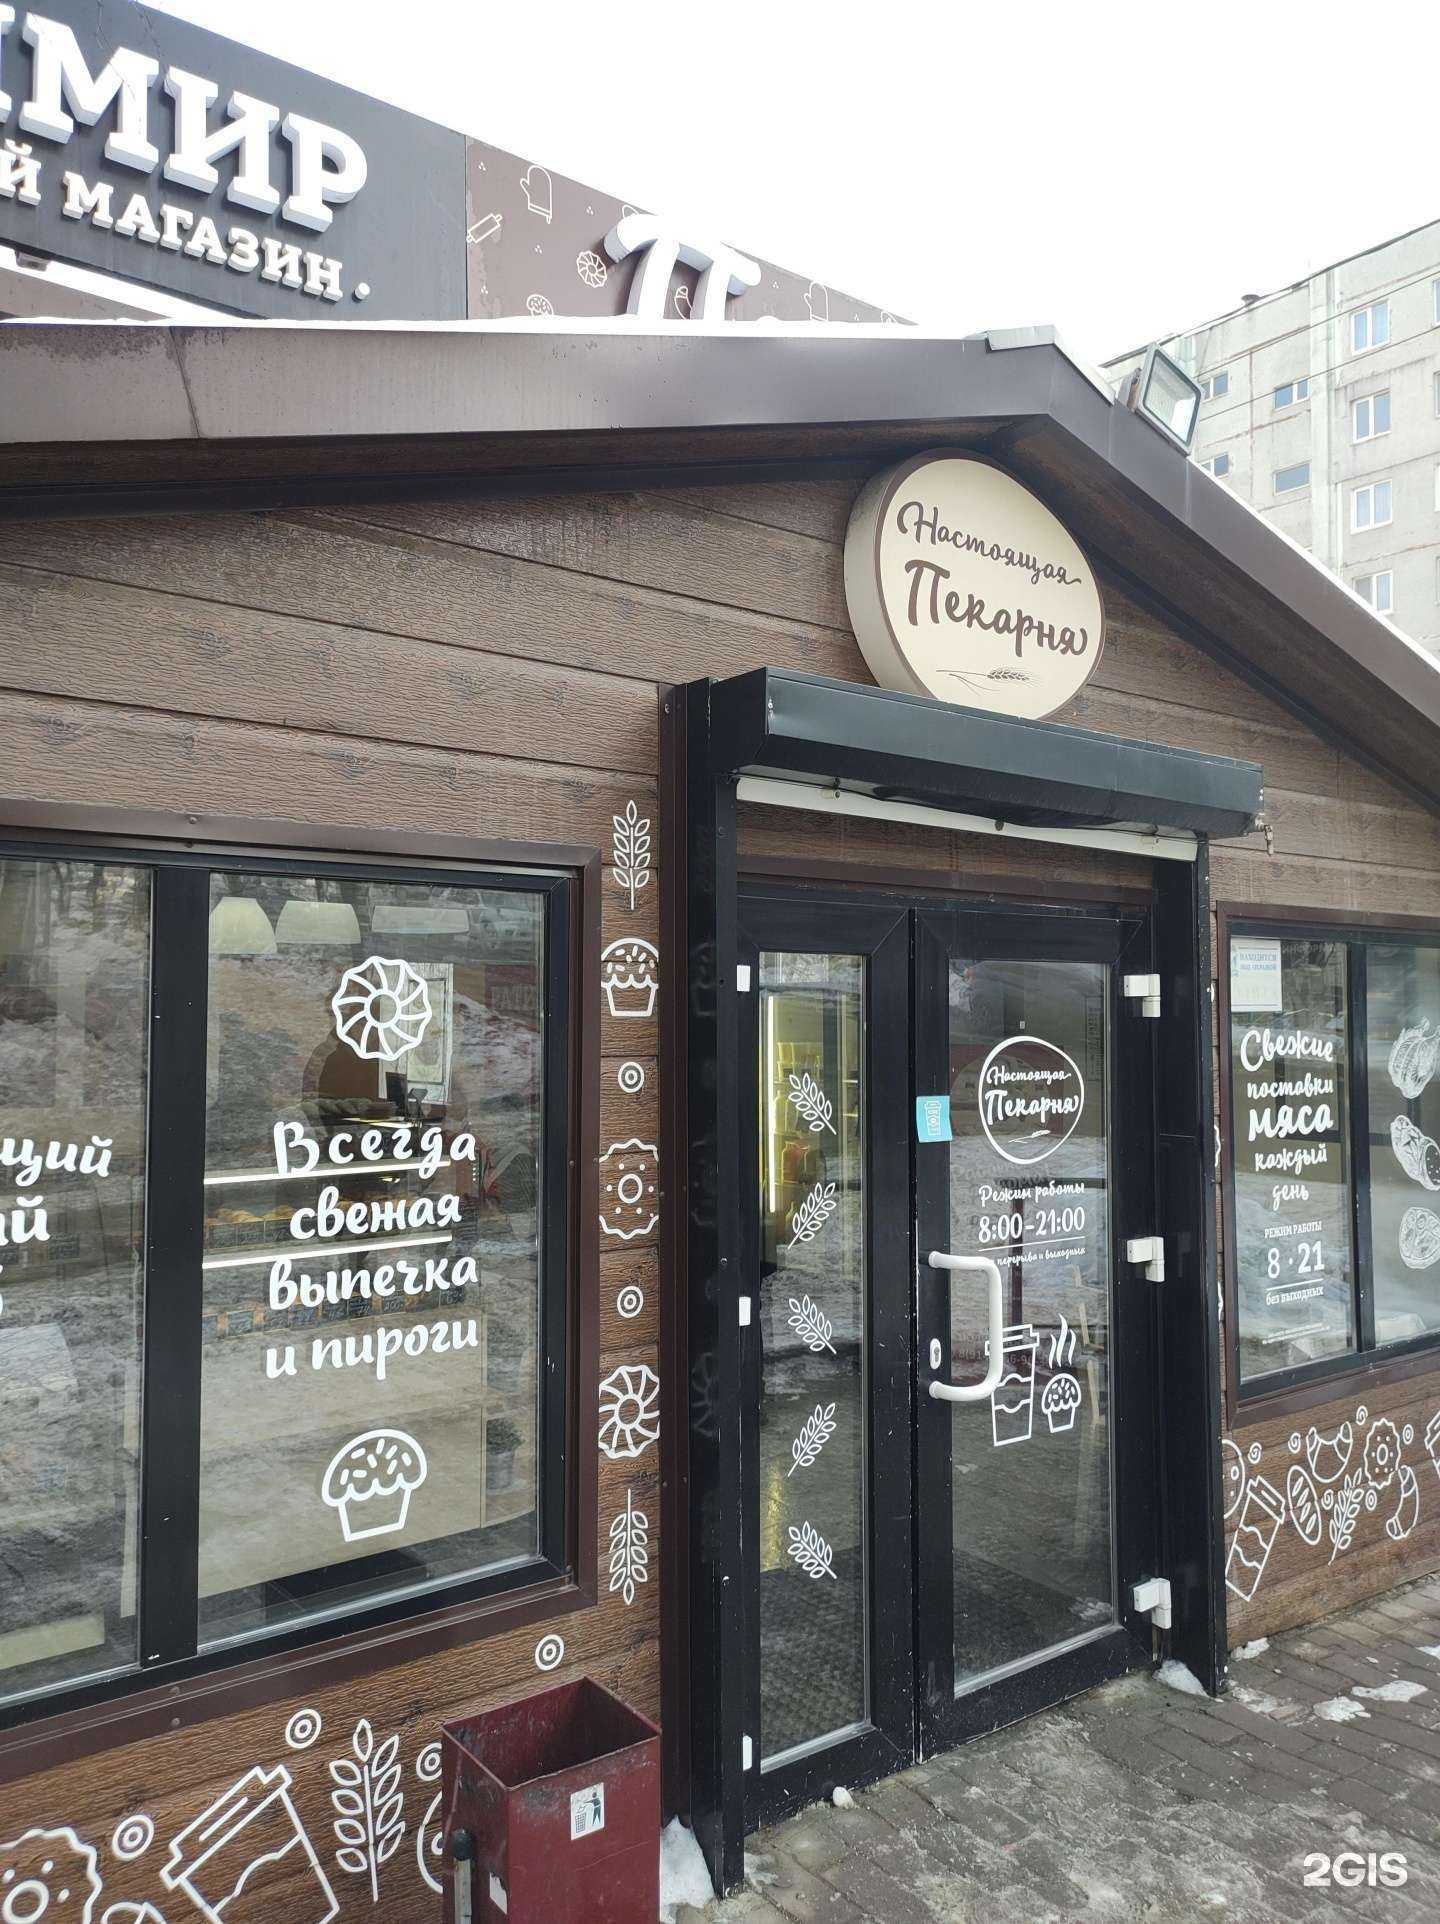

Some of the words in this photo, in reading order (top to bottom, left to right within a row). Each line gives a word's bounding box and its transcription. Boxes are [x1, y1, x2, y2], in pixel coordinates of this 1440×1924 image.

[896, 501, 1082, 584] Настоящая
[905, 559, 1088, 657] Пекарня
[1240, 1028, 1334, 1072] Свежие
[986, 1065, 1072, 1086] Настоящая
[1247, 1072, 1334, 1100] поставки
[984, 1089, 1080, 1126] Пекарня
[273, 1120, 477, 1180] Всегда
[1255, 1143, 1328, 1176] каждый
[289, 1185, 463, 1240] свежая
[979, 1185, 1031, 1208] Режим
[1035, 1180, 1085, 1204] работы
[1272, 1184, 1310, 1212] день
[978, 1206, 1086, 1244] 8:00-21:00
[1264, 1226, 1293, 1239] РЕЖИМ
[1293, 1221, 1323, 1235] РАБОТЫ
[997, 1252, 1038, 1268] перерыва
[1045, 1247, 1086, 1260] выходных
[1267, 1247, 1280, 1279] 8
[1297, 1240, 1325, 1274] 21
[269, 1256, 479, 1310] выпечка
[1266, 1292, 1280, 1306] без
[1281, 1286, 1324, 1303] выходных
[266, 1342, 298, 1380] и
[311, 1319, 479, 1381] пироги
